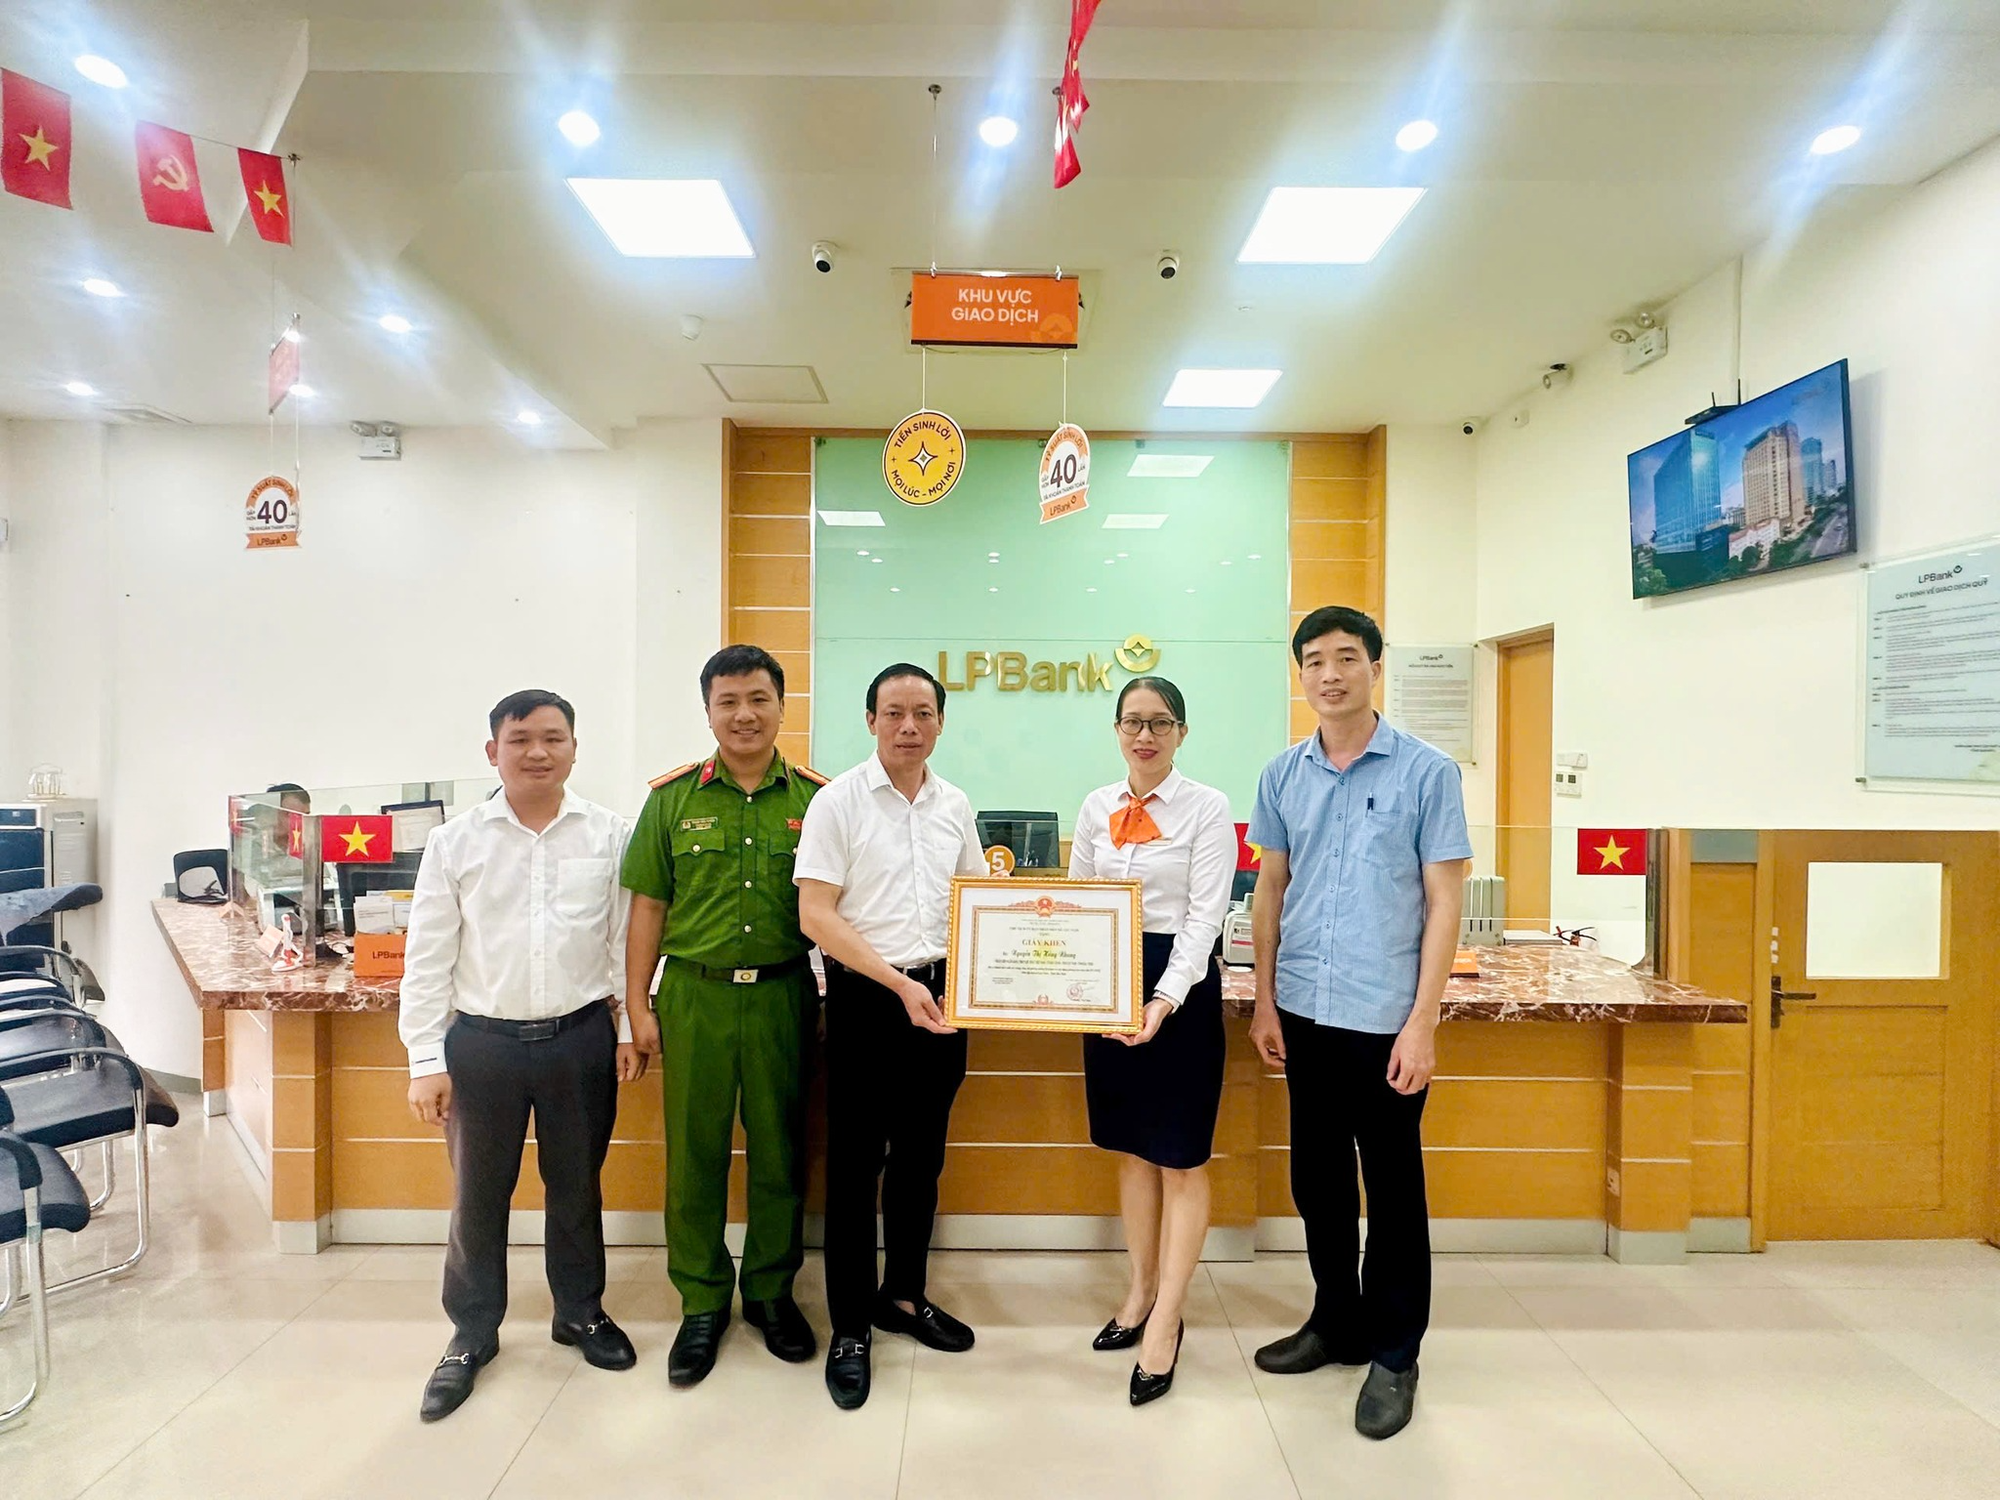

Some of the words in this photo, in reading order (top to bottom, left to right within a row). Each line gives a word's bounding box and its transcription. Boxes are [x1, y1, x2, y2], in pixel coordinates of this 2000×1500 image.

[958, 288, 992, 303] KHU
[996, 287, 1032, 308] VỰC
[951, 307, 995, 322] GIAO
[998, 308, 1039, 326] DỊCH
[894, 427, 913, 448] TIỀN
[912, 420, 936, 432] SINH
[935, 423, 952, 441] LỜI
[891, 469, 905, 489] MỌI
[902, 485, 920, 498] LÚC
[928, 479, 946, 496] MỌI
[943, 461, 956, 482] NƠI
[1050, 453, 1077, 488] 40
[257, 499, 288, 524] 40
[1049, 501, 1071, 516] LPBank
[256, 537, 281, 546] LPBank
[1918, 570, 1953, 584] LPBank
[937, 650, 1113, 692] LPBank
[991, 851, 1006, 871] 5
